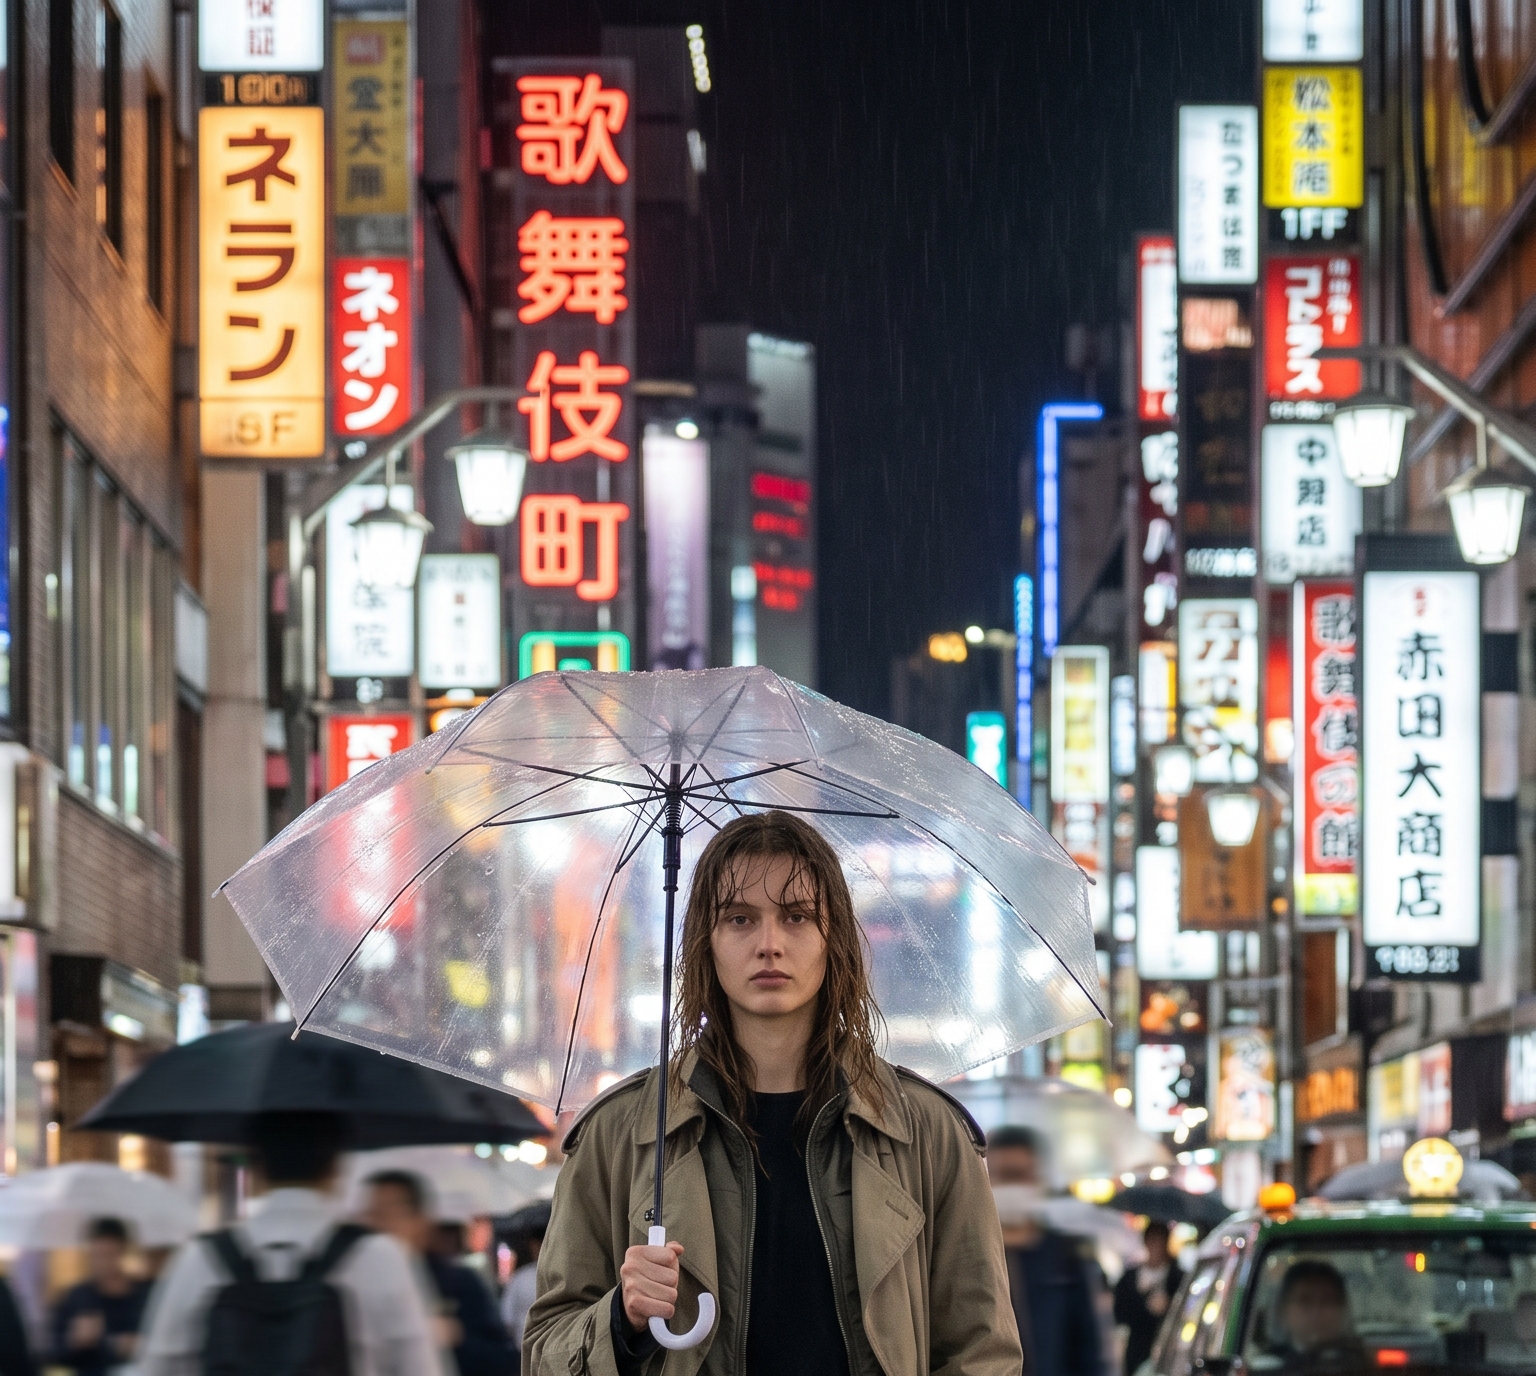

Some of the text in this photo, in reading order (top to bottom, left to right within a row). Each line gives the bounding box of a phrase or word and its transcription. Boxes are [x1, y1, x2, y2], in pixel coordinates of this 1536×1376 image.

[226, 128, 297, 381] ネラン
[1281, 207, 1349, 240] 1FF
[341, 266, 399, 431] ネオン
[516, 74, 629, 602] 歌舞伎町
